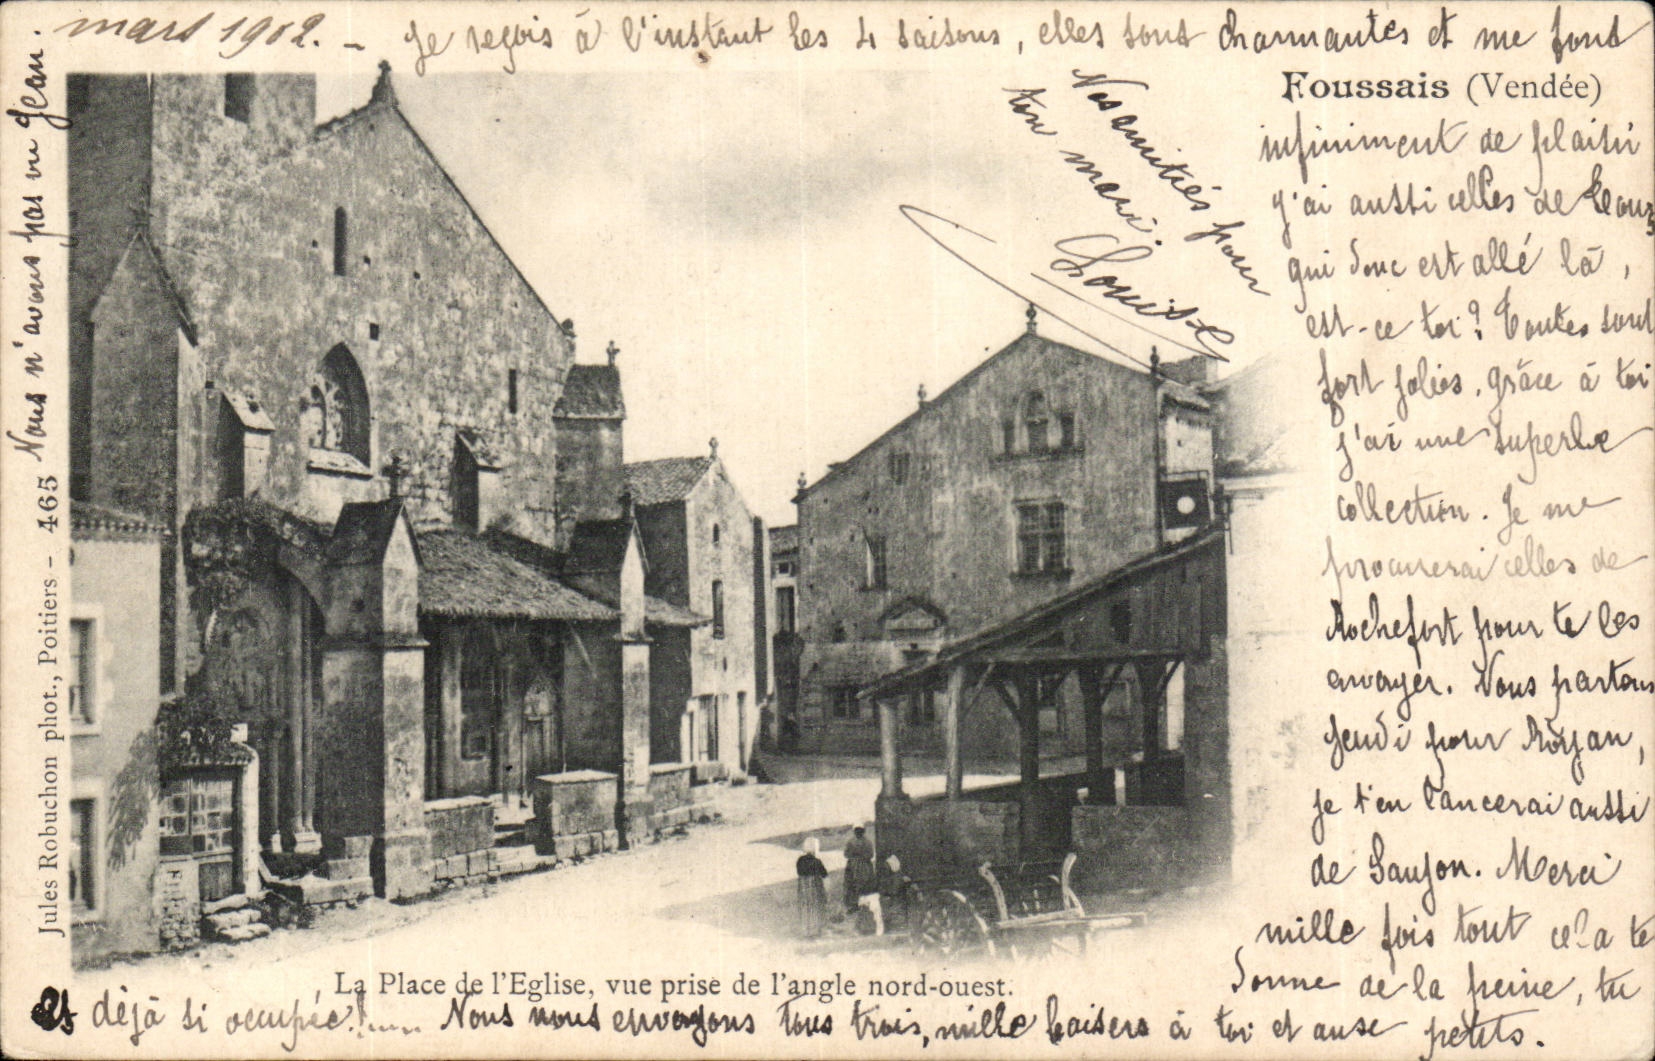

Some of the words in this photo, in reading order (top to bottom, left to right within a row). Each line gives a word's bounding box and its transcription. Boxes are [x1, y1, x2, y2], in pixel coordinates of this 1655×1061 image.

[53, 12, 215, 45] mars
[404, 20, 454, 76] Je
[575, 9, 601, 51] à
[622, 14, 774, 52] l'instant
[789, 11, 829, 51] les
[856, 16, 876, 50] 4
[1039, 10, 1104, 48] elles
[1122, 11, 1207, 49] sont
[1218, 8, 1409, 54] charmantes
[1427, 6, 1457, 49] et
[1474, 27, 1538, 53] me
[1551, 5, 1651, 64] font
[1259, 110, 1469, 184] infiniment
[1480, 126, 1522, 155] de
[1525, 117, 1641, 196] plaisir
[8, 194, 78, 246] pas
[1350, 183, 1437, 216] aussi
[1534, 190, 1577, 216] de
[1288, 250, 1336, 313] qui
[1350, 238, 1407, 278] donc
[1419, 240, 1464, 280] est
[1473, 232, 1544, 276] allé
[1317, 348, 1384, 427] fort
[1487, 358, 1563, 426] grâce
[1580, 361, 1600, 392] à
[1616, 356, 1651, 390] toi
[6, 392, 46, 461] Nous
[1336, 422, 1401, 481] j'ai
[1415, 426, 1490, 451] une
[1494, 409, 1654, 485] superbe
[1497, 483, 1529, 545] Je
[1543, 496, 1622, 520] me
[1504, 534, 1577, 576] celles
[1592, 546, 1648, 573] de
[1326, 592, 1463, 668] Rochefort
[1473, 605, 1544, 672] pour
[1554, 600, 1591, 638] te
[1598, 600, 1640, 638] les
[1472, 650, 1537, 699] Nous
[1425, 721, 1512, 792] pour
[1569, 789, 1651, 824] aussi
[1311, 852, 1357, 887] de
[1497, 837, 1622, 887] Merci
[1255, 907, 1366, 949] mille
[1382, 901, 1435, 974] fois
[1454, 903, 1532, 944] tout
[1232, 945, 1341, 992] donne
[1360, 974, 1408, 999] de
[1414, 963, 1444, 1001] la
[1595, 965, 1641, 1000] tu
[182, 998, 208, 1034] si
[441, 993, 514, 1031] Nous
[528, 1003, 601, 1032] nous
[935, 1001, 1037, 1040] mille
[1046, 993, 1150, 1046] baisers
[1169, 1010, 1192, 1040] à
[1214, 1004, 1254, 1044] toi
[1272, 1009, 1303, 1043] et
